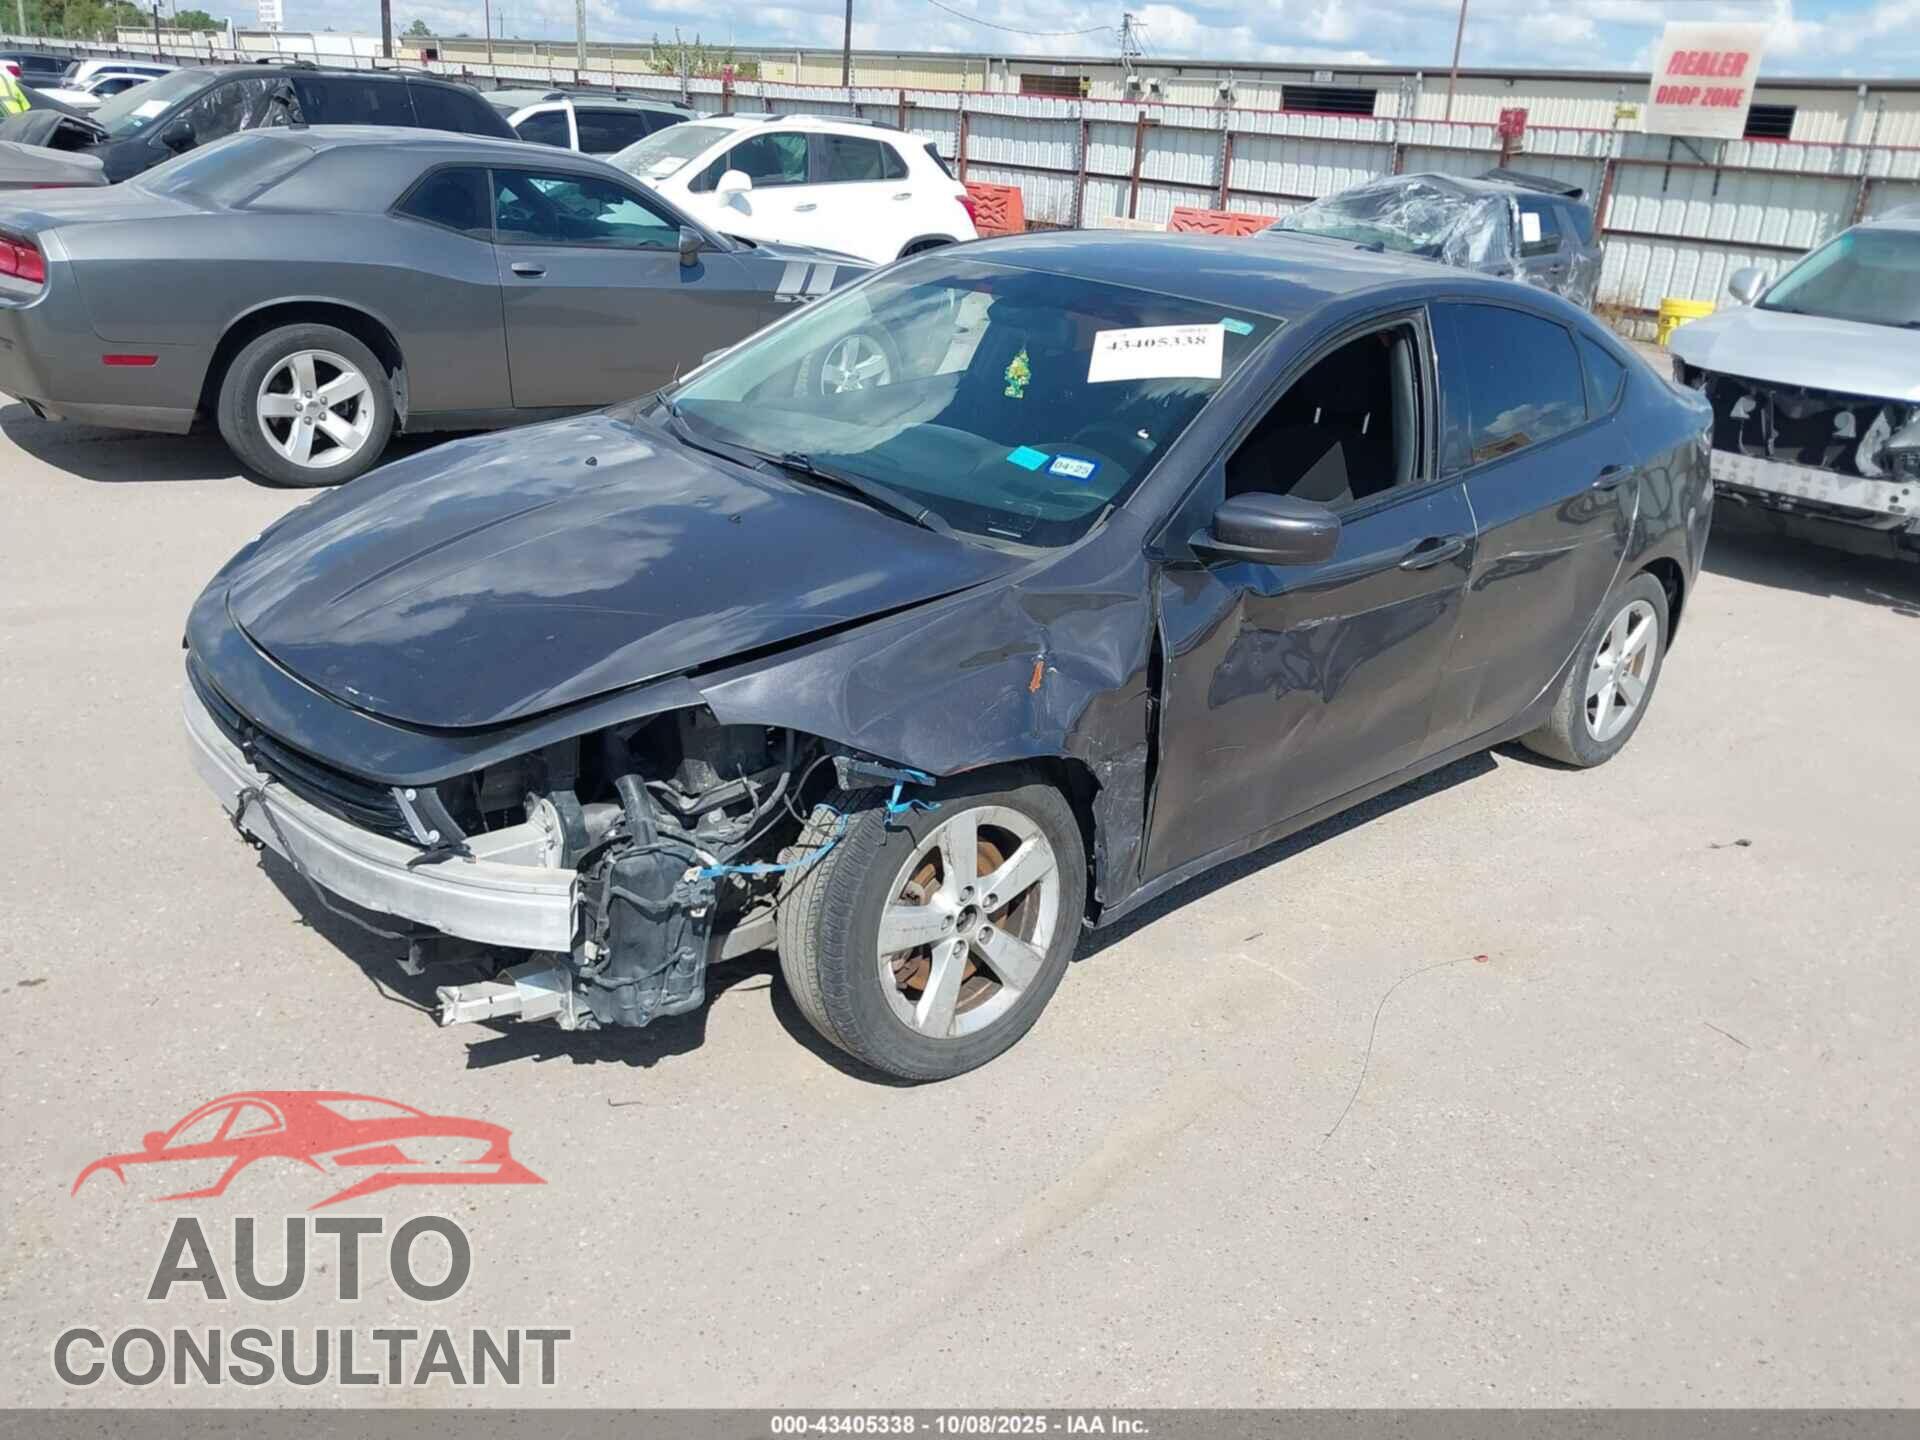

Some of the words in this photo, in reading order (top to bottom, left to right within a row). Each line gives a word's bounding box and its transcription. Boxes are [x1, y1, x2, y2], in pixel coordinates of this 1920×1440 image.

[1667, 51, 1749, 76] DEALER
[1655, 86, 1700, 105] DROP
[1701, 87, 1745, 108] ZONE
[1106, 336, 1206, 350] 43405338
